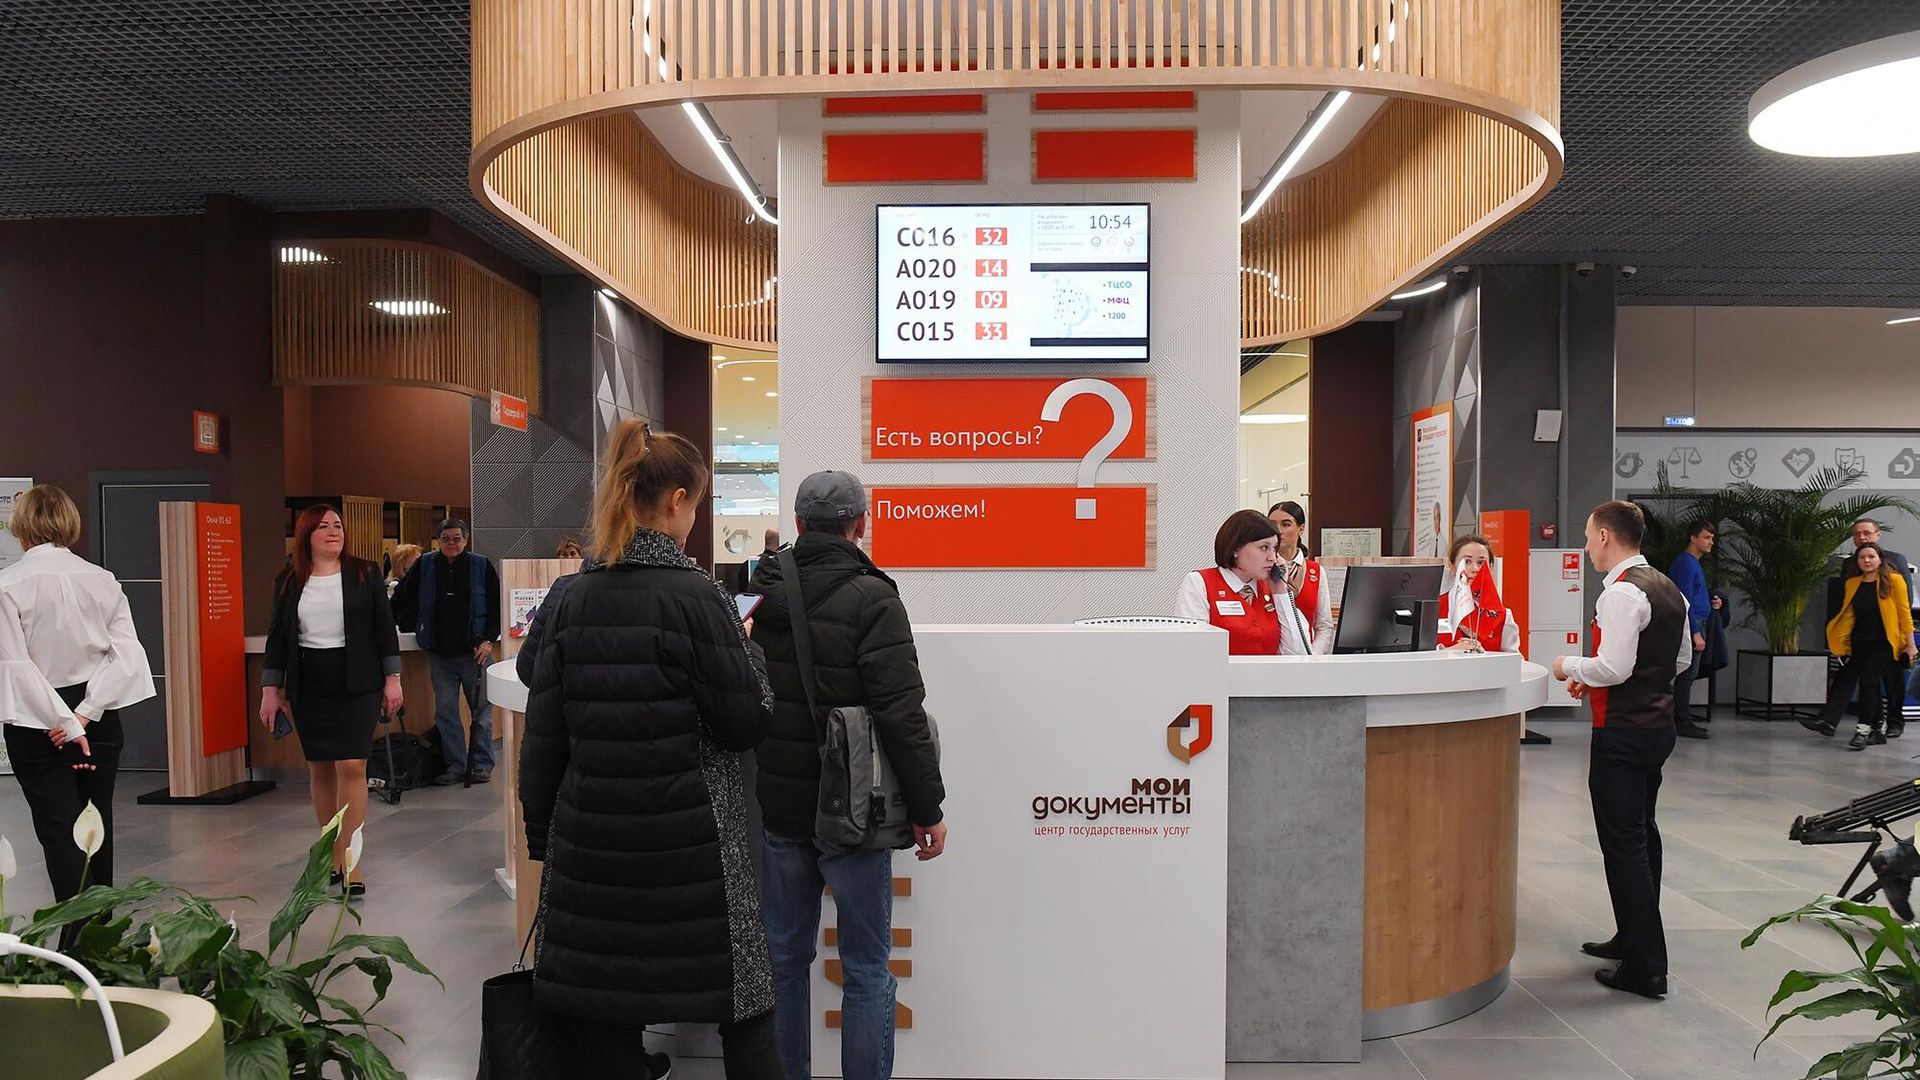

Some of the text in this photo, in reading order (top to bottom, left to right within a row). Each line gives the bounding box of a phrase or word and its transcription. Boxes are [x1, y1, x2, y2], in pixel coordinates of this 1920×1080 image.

[1090, 214, 1132, 229] 10:54
[897, 227, 1003, 247] С016 32
[896, 258, 1004, 278] А020 14
[1107, 281, 1132, 289] ТЦСО
[896, 290, 1003, 310] А019 09
[1107, 297, 1130, 305] МФЦ
[1107, 312, 1126, 320] 1200
[897, 321, 1003, 341] С015 33
[876, 426, 1043, 450] Есть вопросы?
[877, 500, 986, 519] Поможем!
[1032, 796, 1191, 820] документы
[1034, 825, 1190, 837] центр государственных услуг
